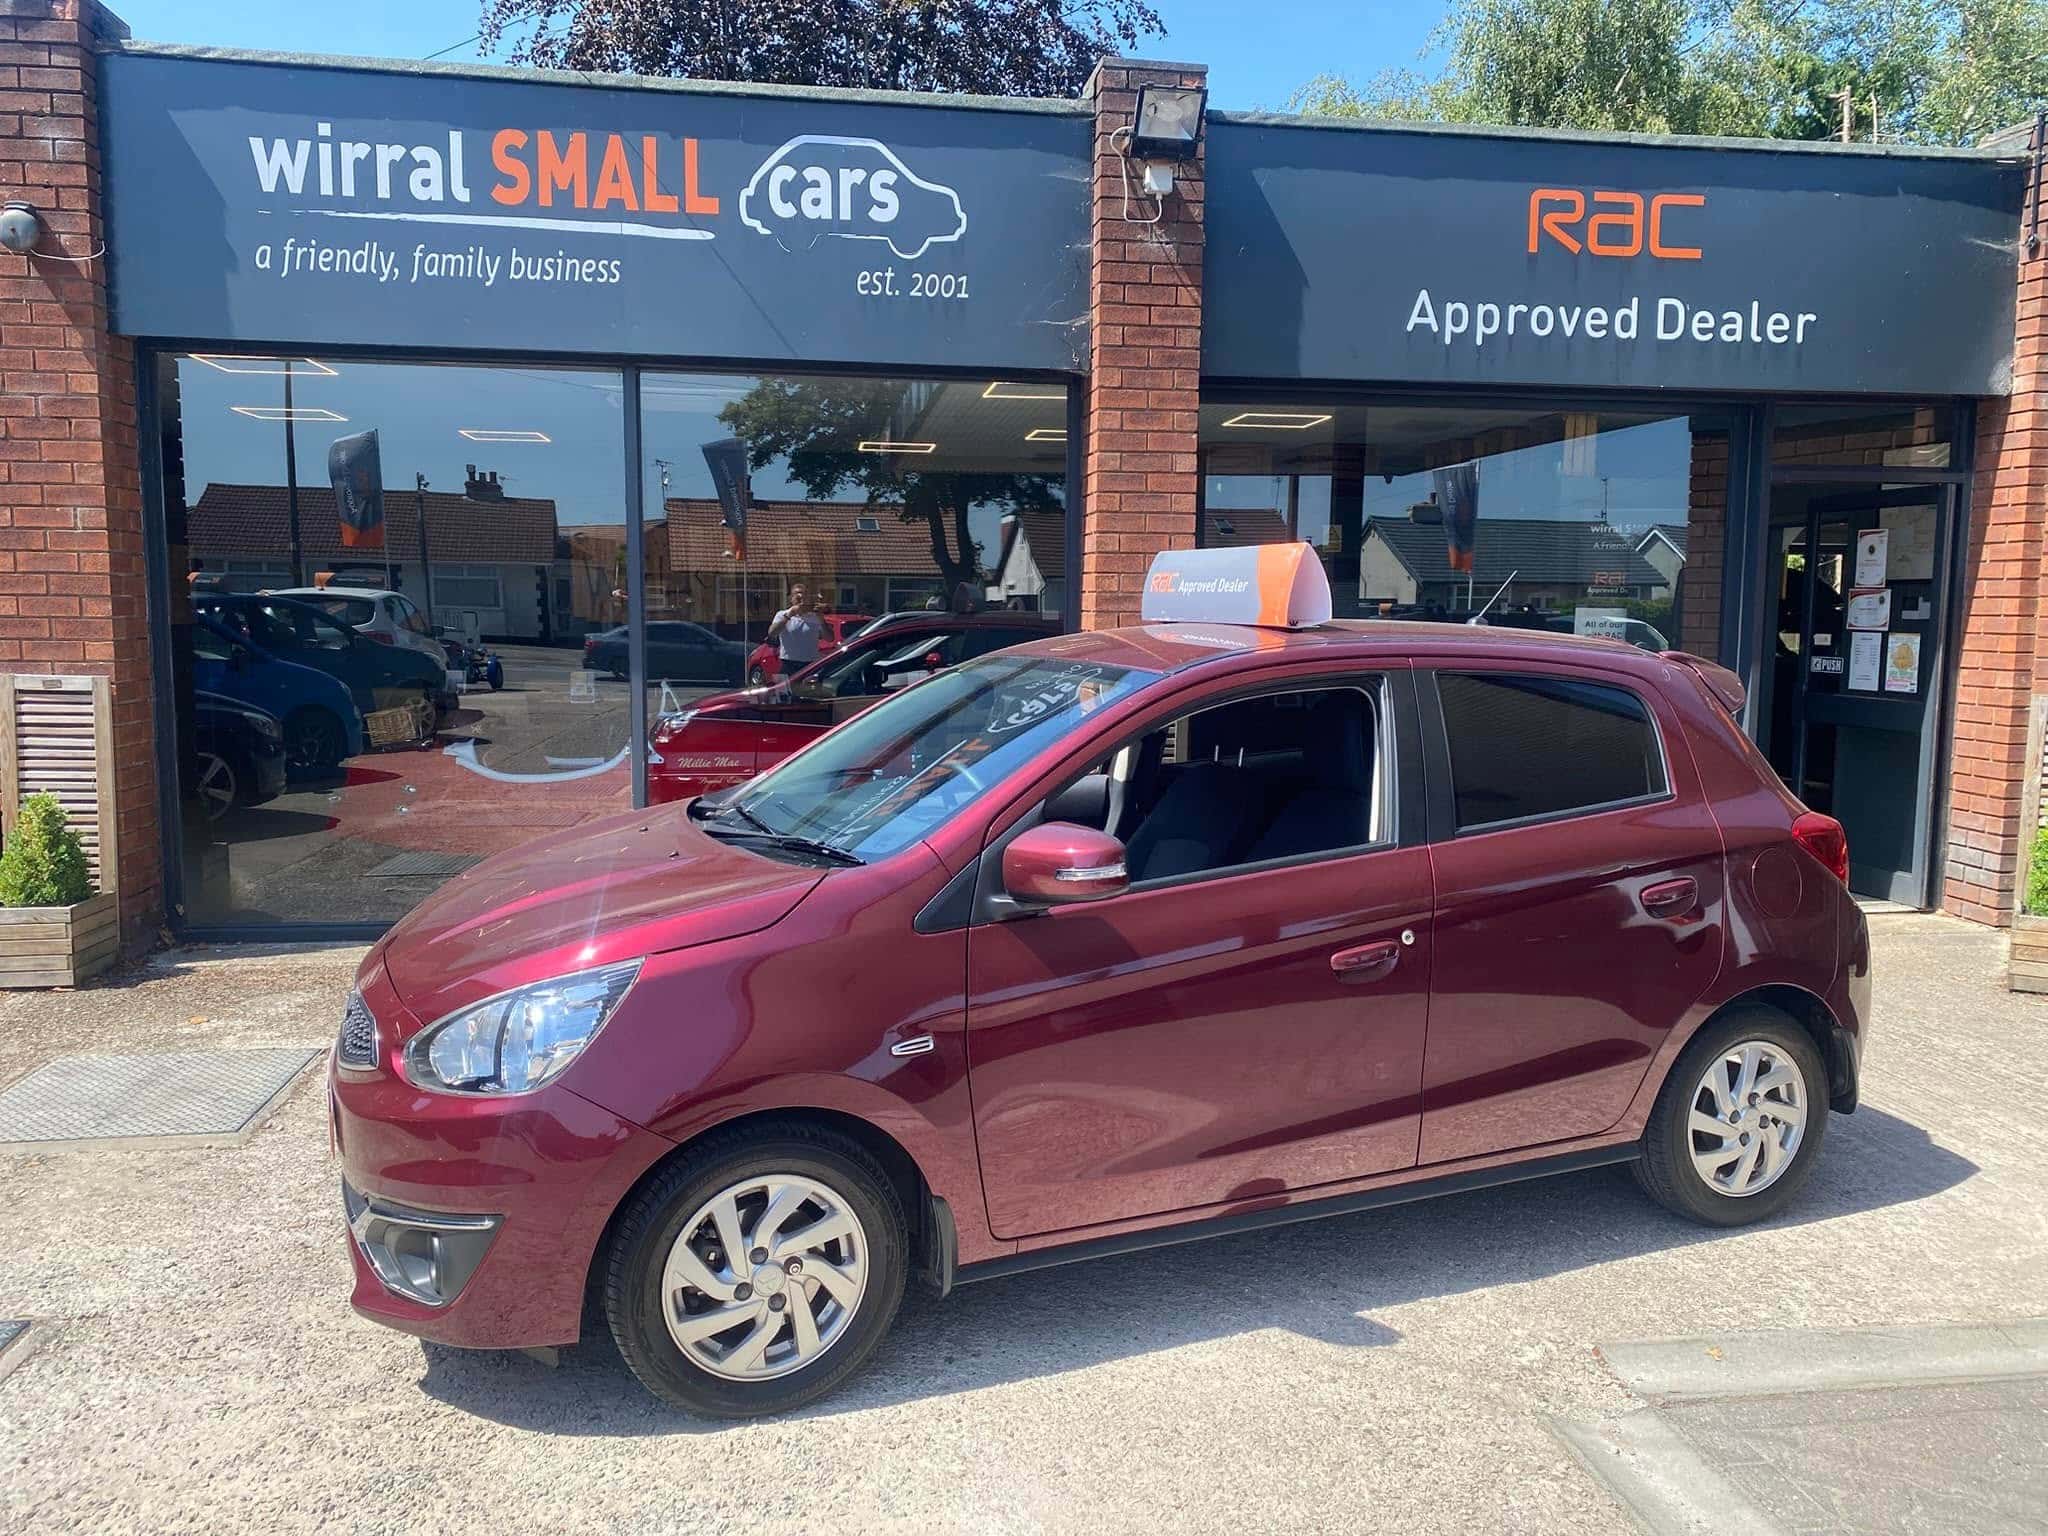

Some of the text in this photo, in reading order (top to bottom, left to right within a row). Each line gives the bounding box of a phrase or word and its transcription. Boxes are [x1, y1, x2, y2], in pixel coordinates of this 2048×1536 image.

[248, 122, 900, 223] wirral SMALL cars
[255, 238, 621, 287] a friendly, family business
[856, 267, 970, 299] est. 2001
[1406, 289, 1817, 346] Approved Dealer
[1178, 577, 1217, 597] Approved
[1218, 578, 1248, 593] Dealer
[1585, 620, 1597, 629] All
[1821, 658, 1842, 672] PUSH
[677, 756, 741, 769] Millie Mac
